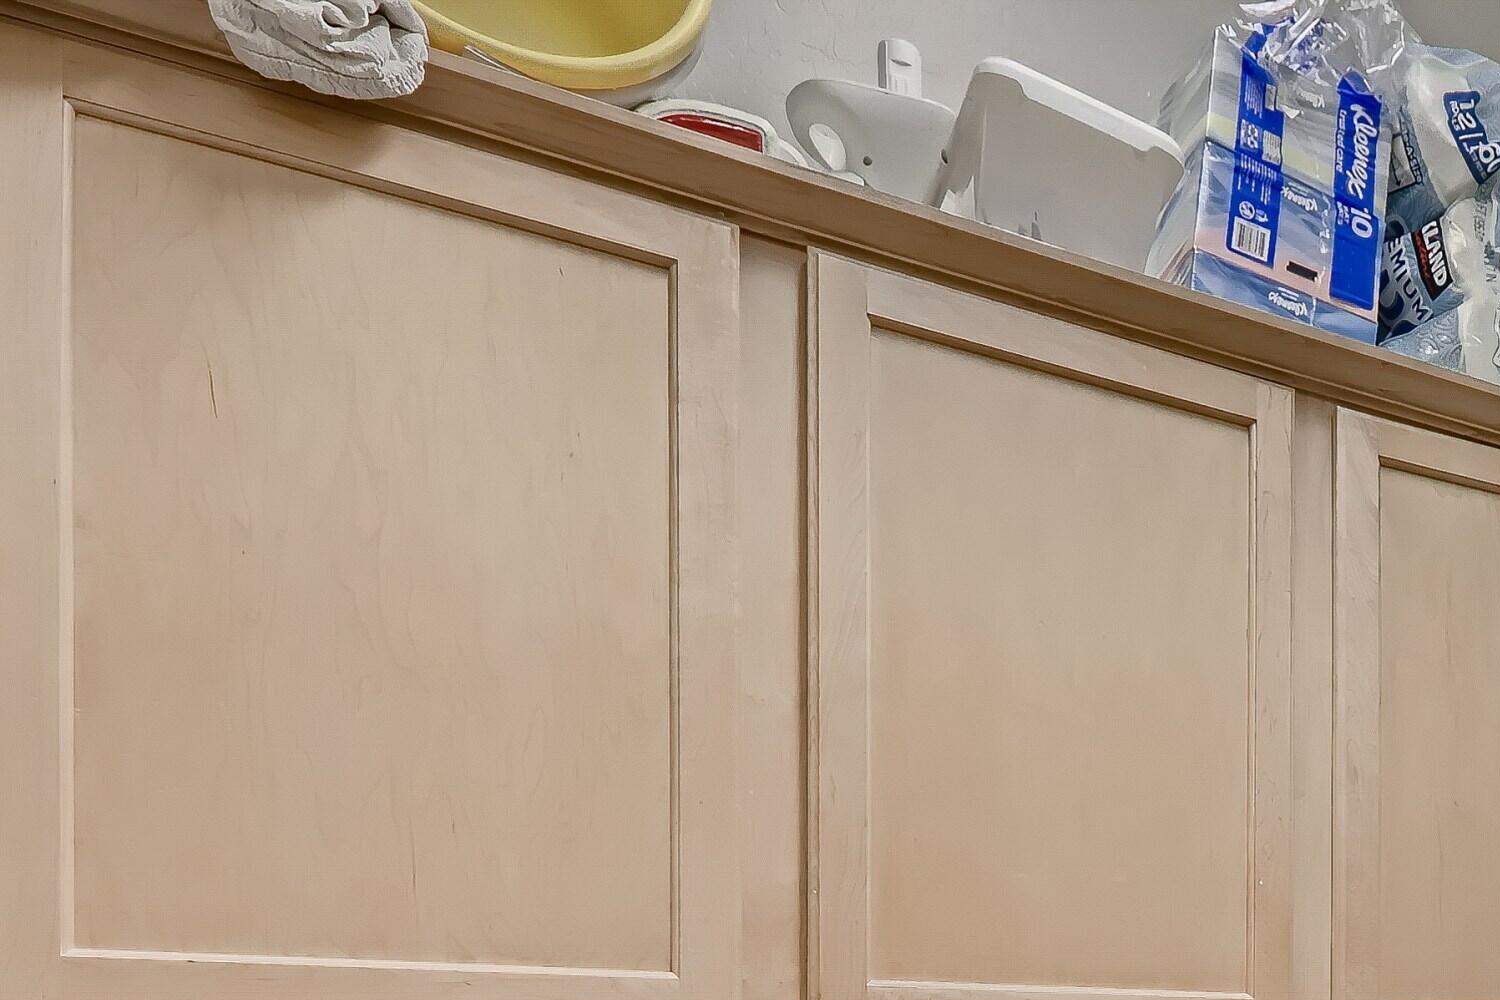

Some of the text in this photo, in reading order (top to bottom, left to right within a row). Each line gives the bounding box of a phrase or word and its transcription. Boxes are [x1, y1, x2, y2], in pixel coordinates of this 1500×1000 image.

[1458, 98, 1477, 131] 12
[1346, 101, 1378, 201] Kleenex
[1350, 206, 1374, 239] 10
